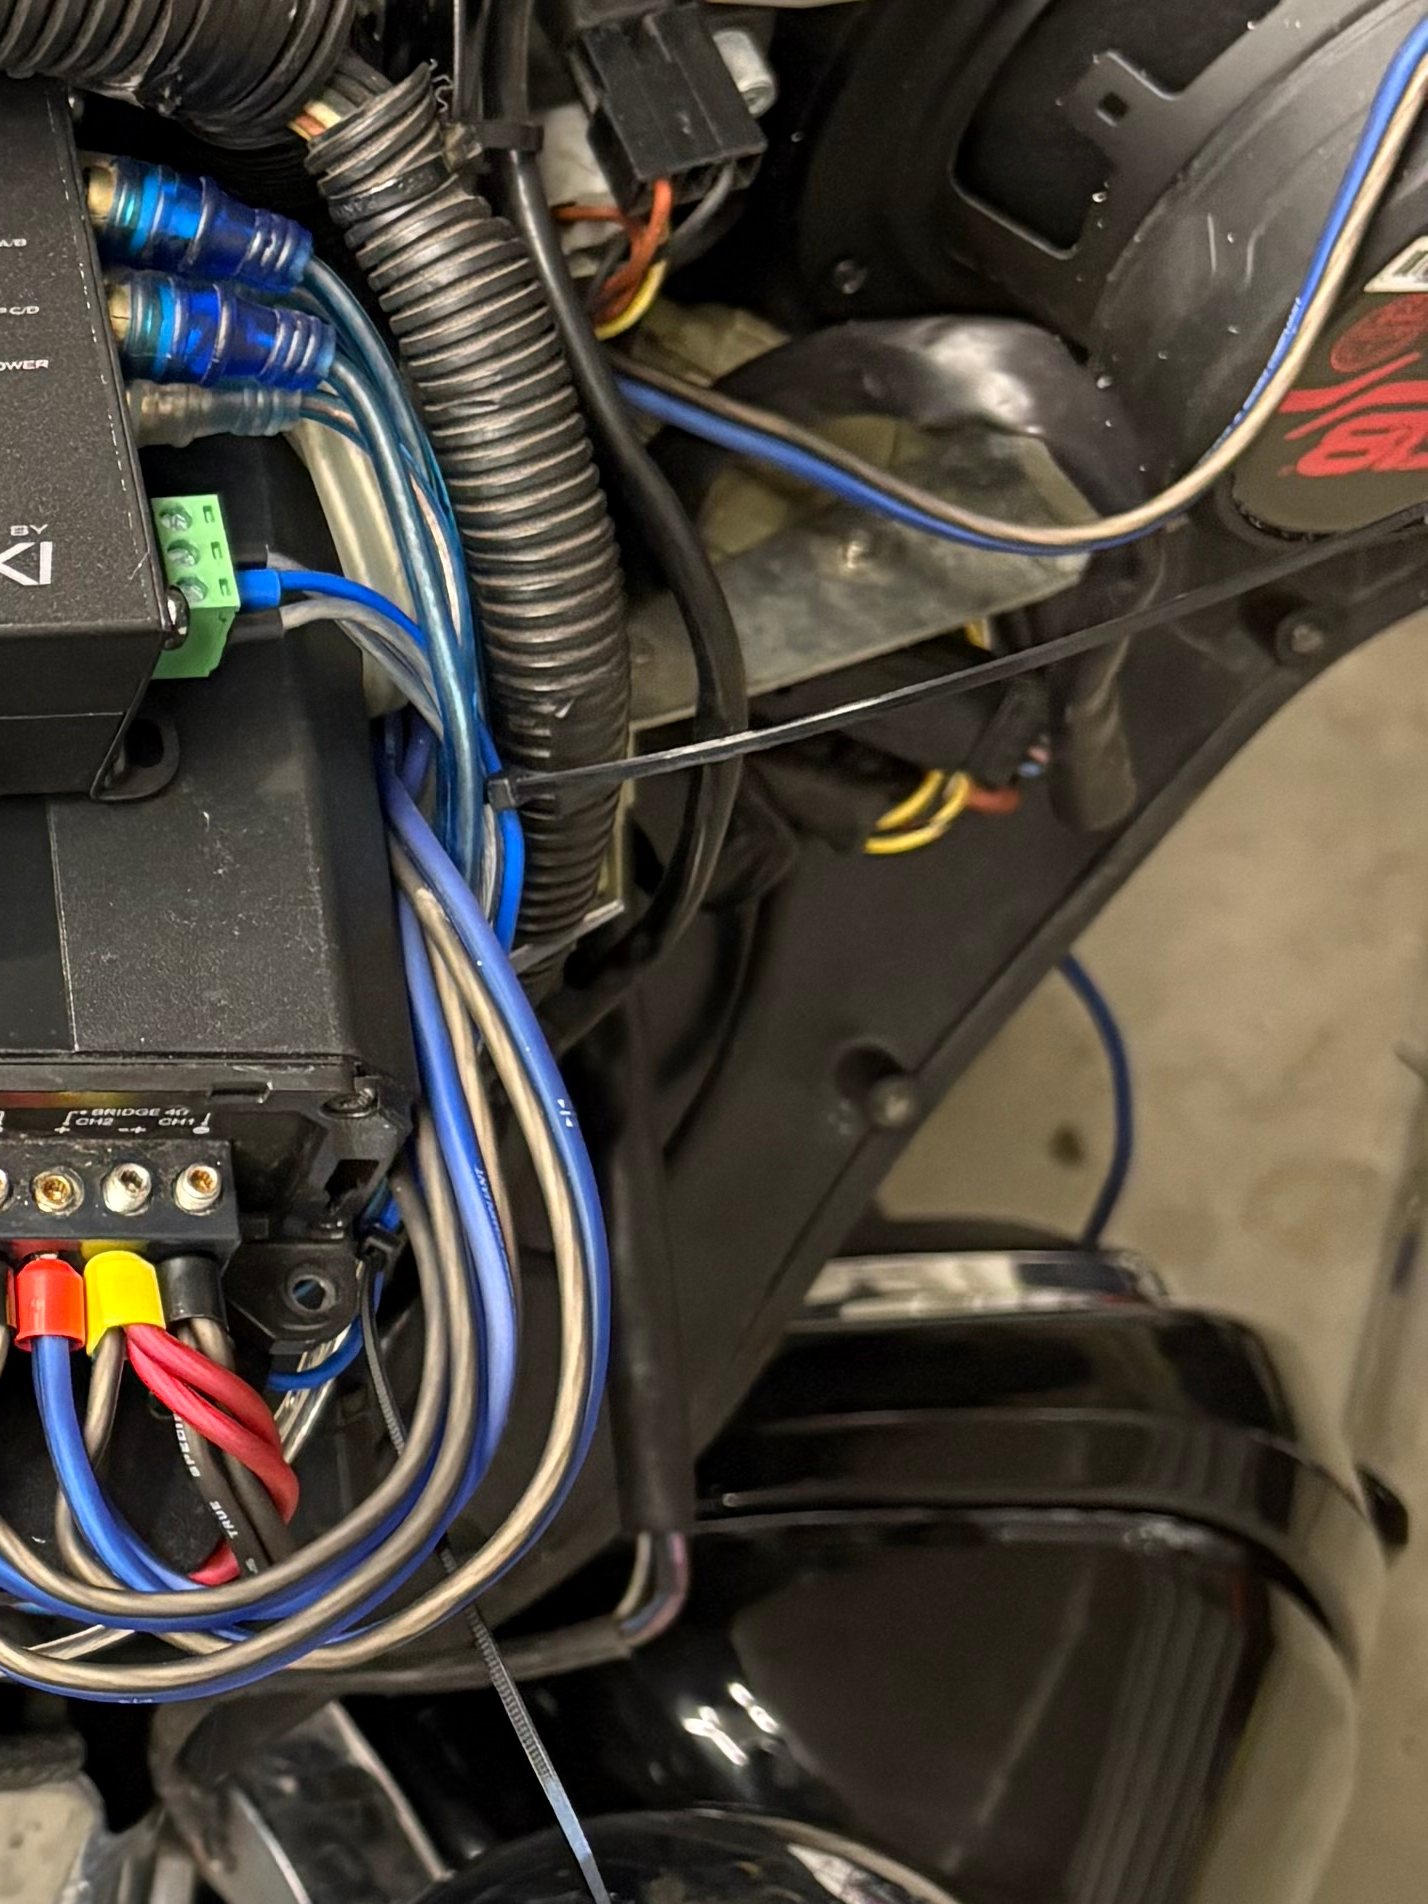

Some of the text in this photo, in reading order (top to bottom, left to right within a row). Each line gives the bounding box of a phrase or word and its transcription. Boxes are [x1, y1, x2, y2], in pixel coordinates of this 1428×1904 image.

[9, 305, 40, 316] C/D
[10, 523, 49, 537] BY
[87, 1107, 160, 1117] BRIDGE
[209, 1500, 238, 1539] TRUE
